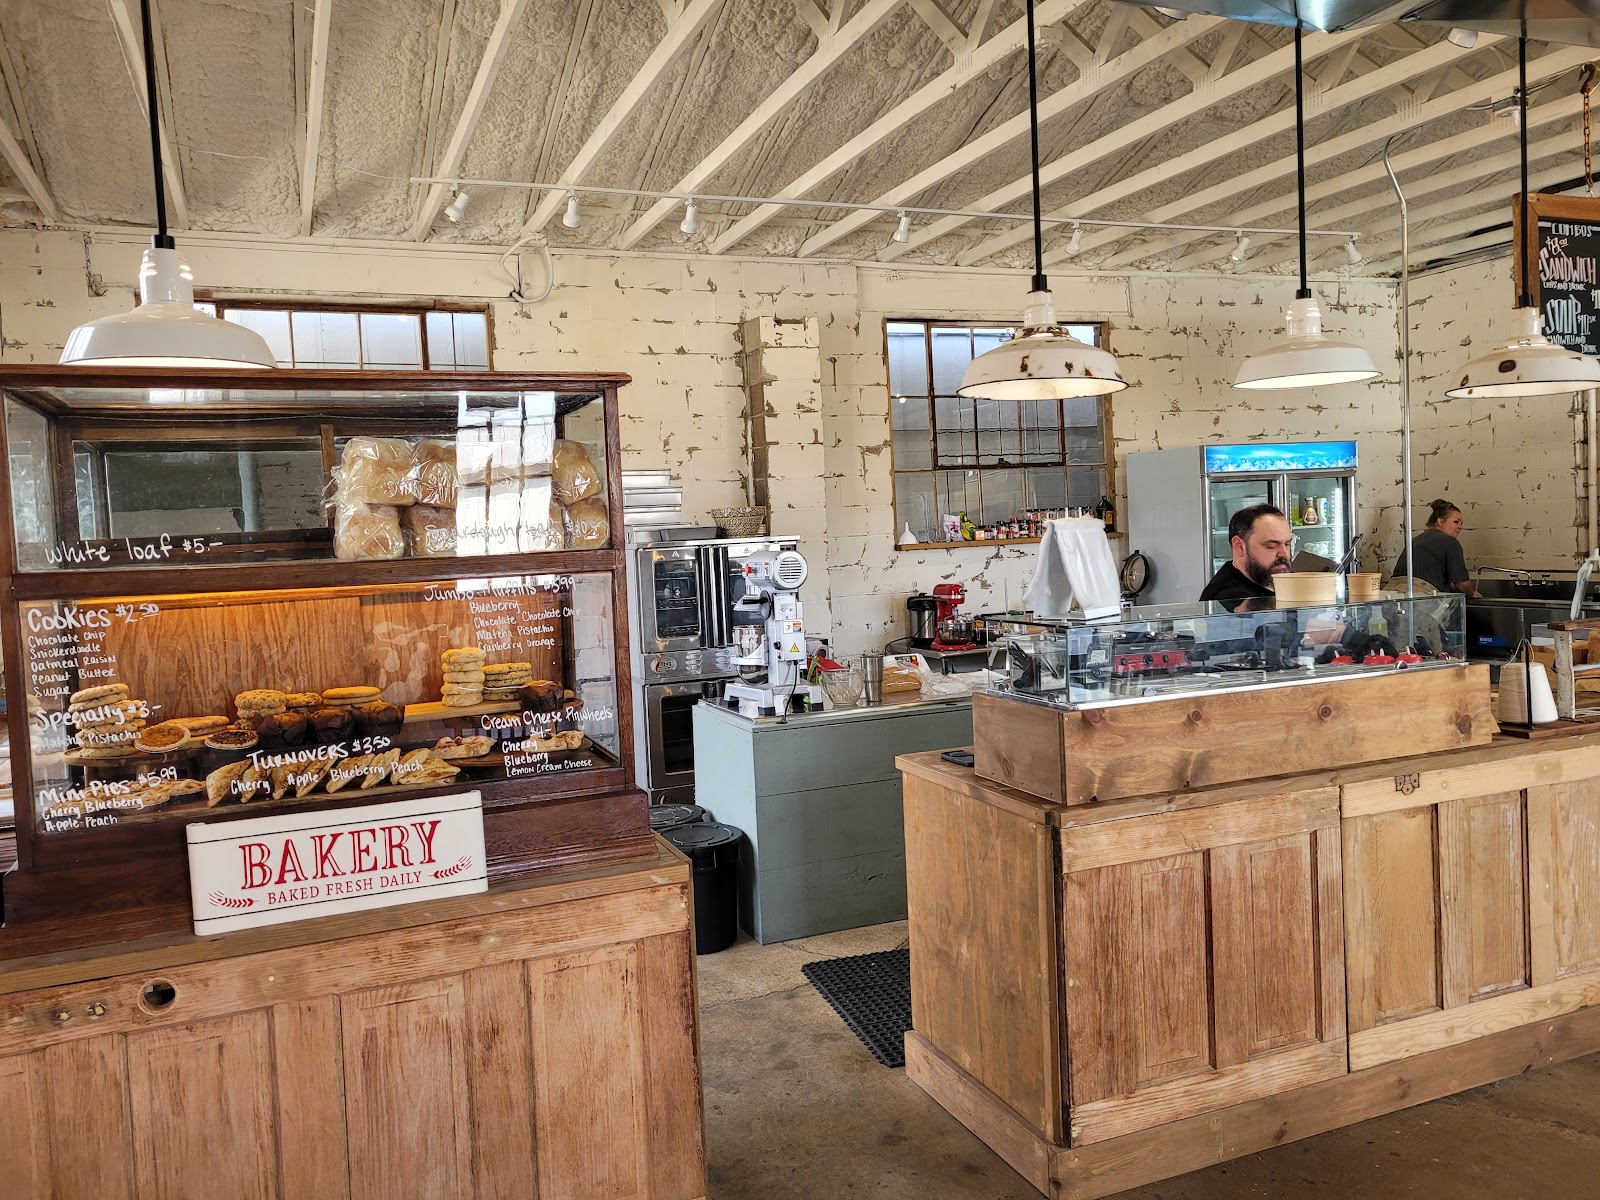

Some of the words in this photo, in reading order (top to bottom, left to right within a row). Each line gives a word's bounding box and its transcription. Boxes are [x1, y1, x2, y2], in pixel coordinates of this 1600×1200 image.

[1551, 223, 1592, 237] COMBOS
[1539, 247, 1596, 285] SANDWICH
[1545, 294, 1582, 335] SOUP
[125, 533, 173, 560] loaf
[424, 584, 474, 602] Jumbo
[469, 600, 520, 614] Blueberry
[28, 607, 112, 632] Cookies
[474, 615, 516, 629] Chocolate
[522, 608, 561, 622] Chocolate
[28, 634, 80, 648] Chocolate
[476, 630, 513, 641] Matcha
[517, 624, 554, 635] Pistachio
[29, 643, 101, 660] Snickerdoodle
[477, 640, 522, 653] Cranberry
[31, 658, 79, 673] Oatmeal
[32, 671, 71, 685] Peanut
[36, 705, 126, 732] Specialty
[481, 714, 522, 731] Cream
[523, 710, 563, 726] Cheese
[565, 706, 613, 721] Pinwheels
[87, 730, 142, 744] Pistachio
[352, 736, 391, 754] $3.50
[504, 752, 549, 767] Blueberry
[536, 763, 562, 773] Cream
[564, 758, 592, 770] Cheese
[39, 783, 86, 806] Mini
[89, 779, 131, 797] Pies
[137, 766, 178, 788] $5.99
[231, 779, 270, 795] Cherry
[287, 771, 319, 787] Apple
[330, 764, 385, 782] Blueberry
[390, 760, 424, 775] Peach
[42, 806, 81, 820] Cherry
[85, 797, 144, 813] Blueberry
[238, 820, 442, 890] BAKERY
[267, 885, 320, 905] BAKED
[326, 877, 374, 896] FRESH
[379, 871, 423, 888] DAILY
